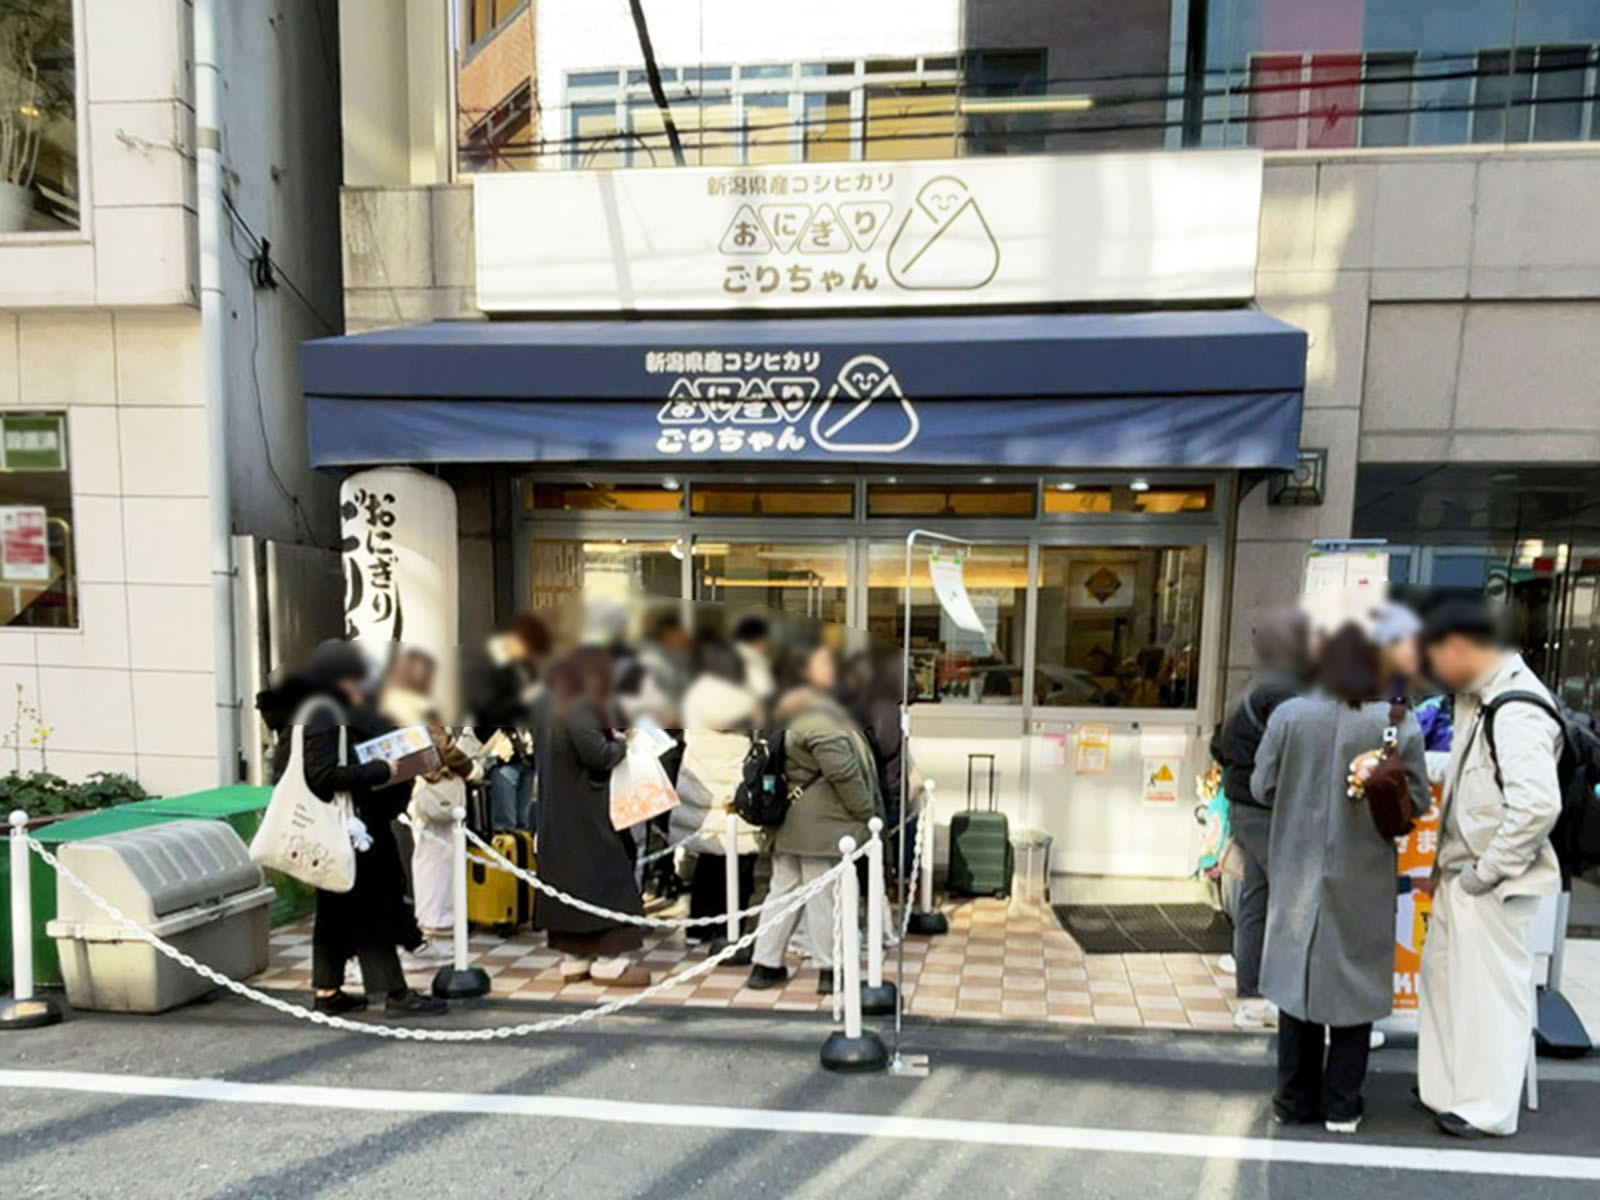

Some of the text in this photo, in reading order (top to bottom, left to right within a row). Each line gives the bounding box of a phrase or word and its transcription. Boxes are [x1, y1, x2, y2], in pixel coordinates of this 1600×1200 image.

[706, 173, 894, 196] 新潟県産コシヒカリ
[732, 211, 877, 248] おにぎり
[722, 263, 879, 294] ごりちゃん
[645, 352, 820, 373] 新潟県産コシヒカリ
[656, 426, 806, 453] ごりちゃん
[363, 492, 399, 624] おにぎり
